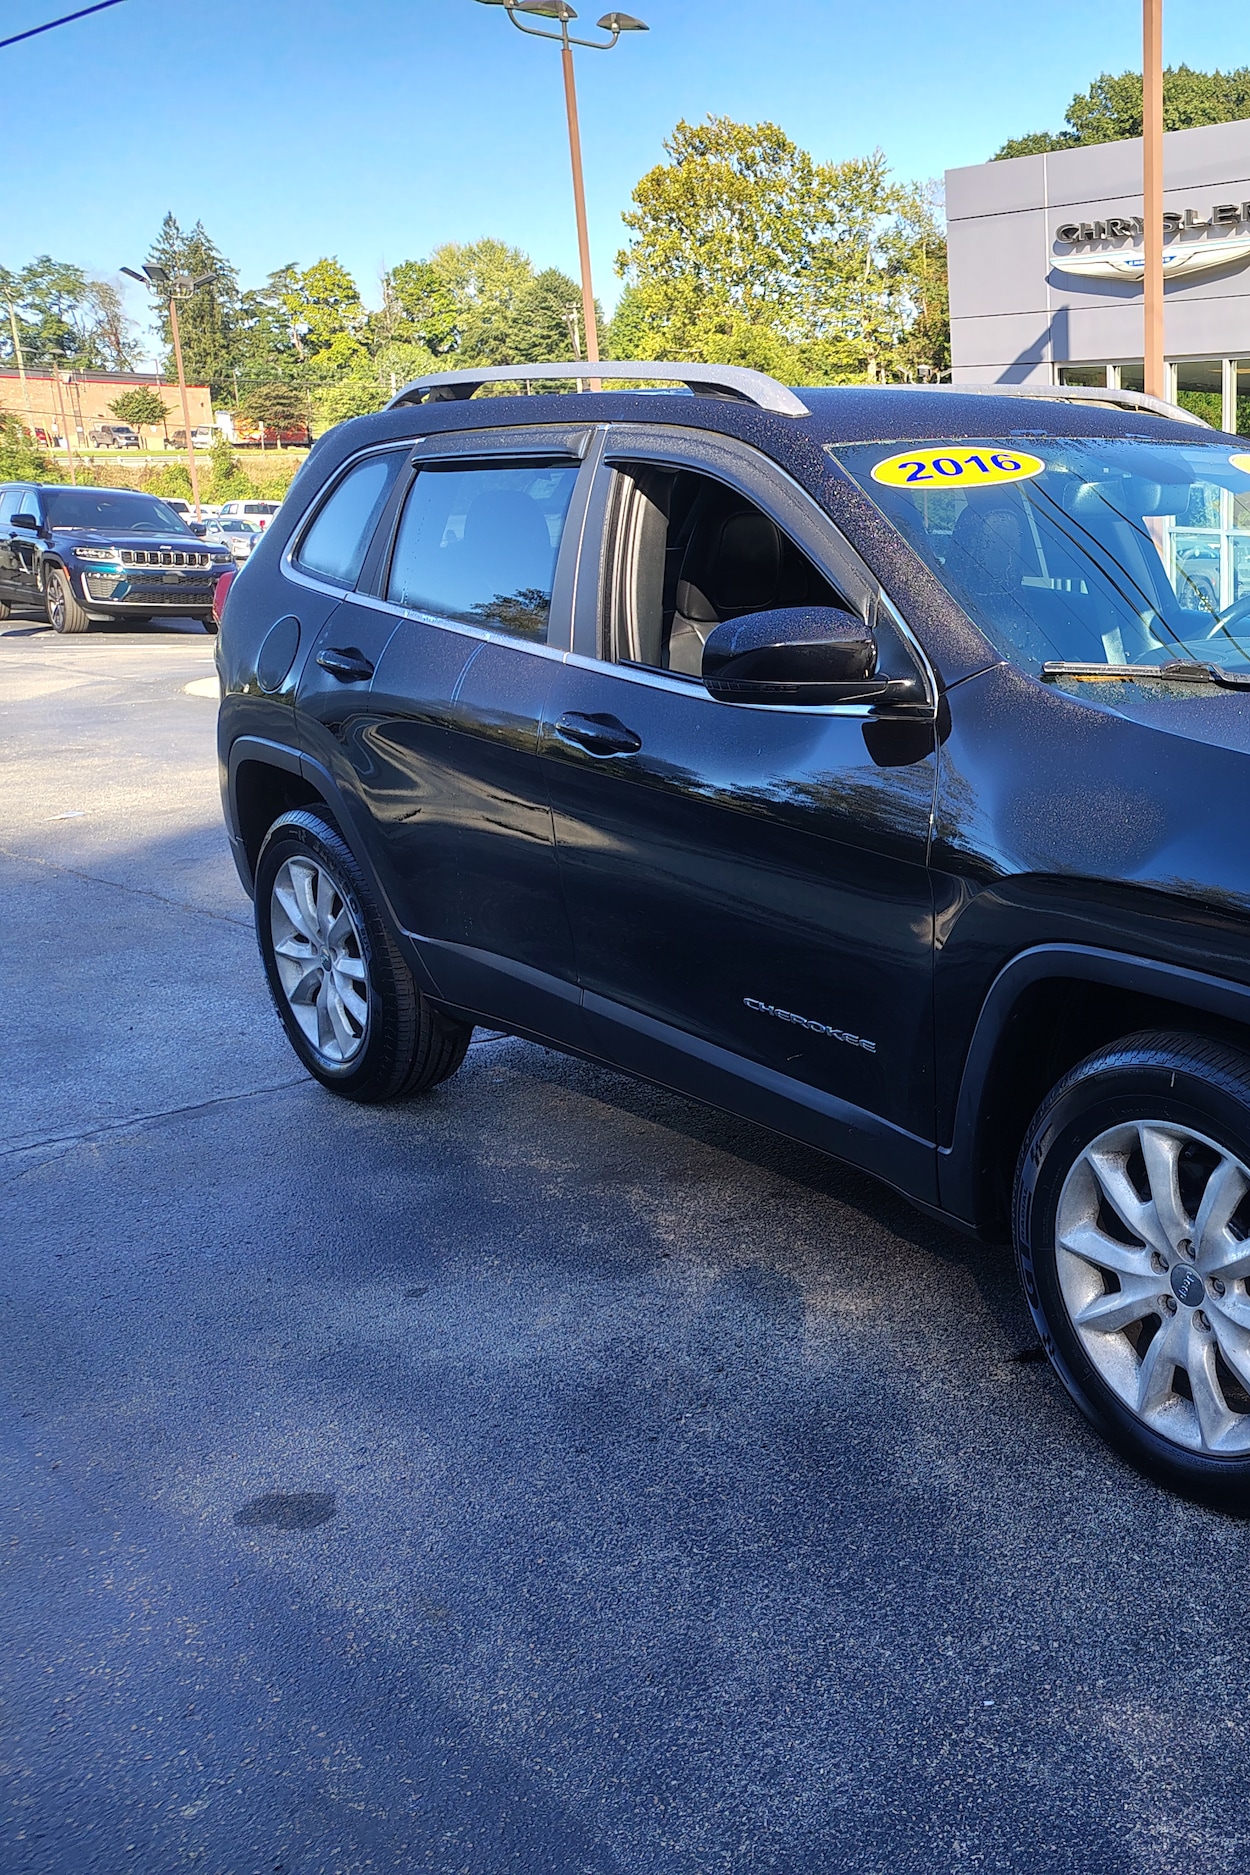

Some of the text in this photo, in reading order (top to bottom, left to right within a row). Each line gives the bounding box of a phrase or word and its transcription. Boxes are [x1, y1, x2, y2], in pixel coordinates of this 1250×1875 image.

[898, 453, 1022, 483] 2016
[743, 997, 877, 1053] CHEROKEE
[1178, 1271, 1195, 1300] Jeep
